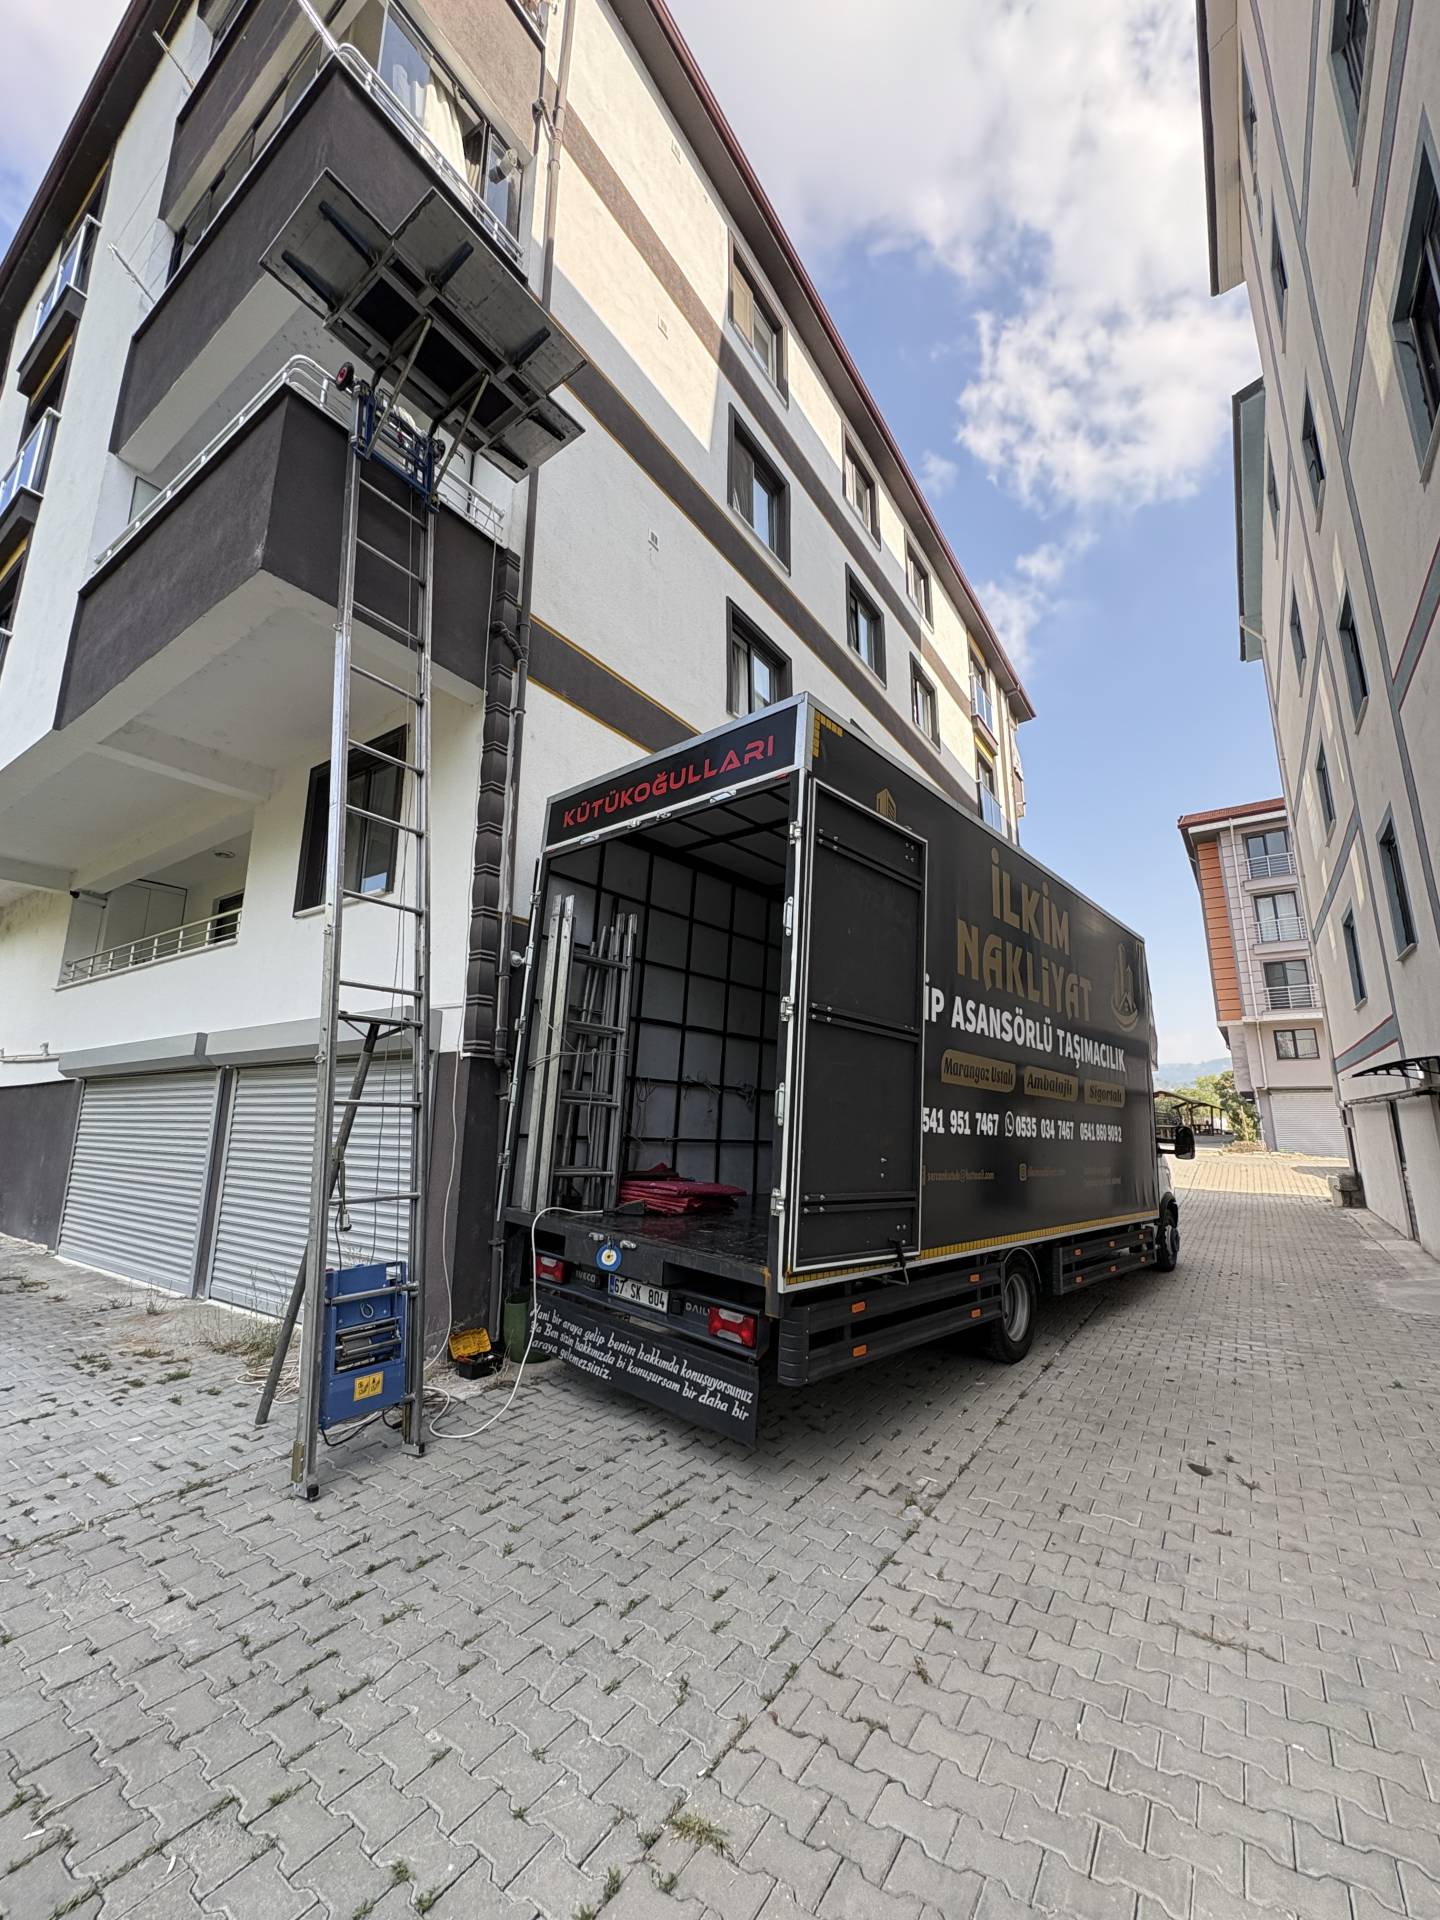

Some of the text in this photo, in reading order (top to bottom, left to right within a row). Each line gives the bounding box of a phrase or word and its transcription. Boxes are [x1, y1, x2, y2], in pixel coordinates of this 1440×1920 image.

[562, 735, 775, 827] KÜTÜKOĞULLARI
[991, 847, 1071, 956] İLKİM
[957, 918, 1093, 1021] NAKLİYAT
[951, 995, 1053, 1053] ASANSÖRLÜ
[1057, 1028, 1126, 1072] TAŞIMACILIK
[944, 1057, 990, 1084] Marangoz
[1026, 1072, 1073, 1098] Ambalajlı
[950, 1110, 971, 1135] 951
[975, 1112, 999, 1136] 7467
[1015, 1115, 1074, 1140] 0535 034 7467
[575, 1270, 596, 1283] IVECO
[614, 1278, 665, 1309] 67 SK 804
[531, 1339, 613, 1380] araya gelemezsiniz.
[544, 1322, 559, 1339] Ben
[559, 1332, 574, 1347] sizin
[616, 1354, 627, 1369] bi
[627, 1358, 681, 1393] konuşursam
[682, 1381, 698, 1399] bir
[699, 1389, 729, 1412] daha
[731, 1401, 750, 1421] bir
[552, 1309, 562, 1325] bir
[562, 1320, 583, 1336] araya
[583, 1326, 605, 1346] gelip
[607, 1332, 636, 1356] benim
[637, 1343, 679, 1375] hakkımda
[680, 1359, 754, 1404] konuşuyorsunuz
